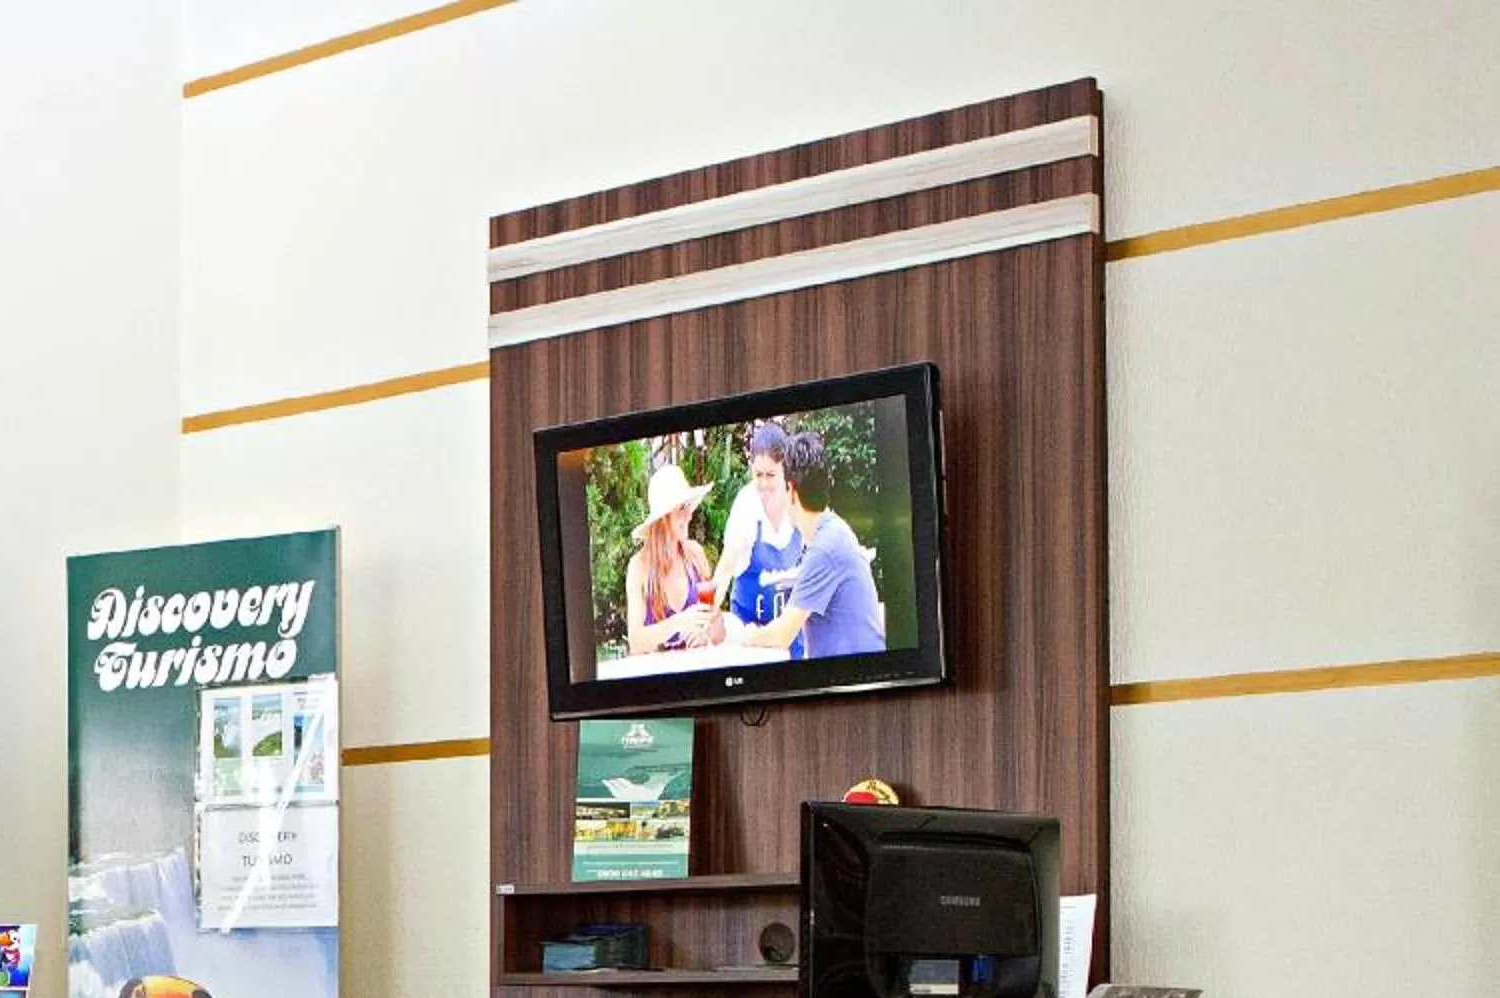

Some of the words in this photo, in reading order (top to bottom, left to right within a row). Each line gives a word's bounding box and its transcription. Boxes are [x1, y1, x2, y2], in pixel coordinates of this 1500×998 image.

[87, 580, 315, 639] Discovery
[94, 635, 297, 692] Turismo
[238, 832, 297, 843] DISCERY
